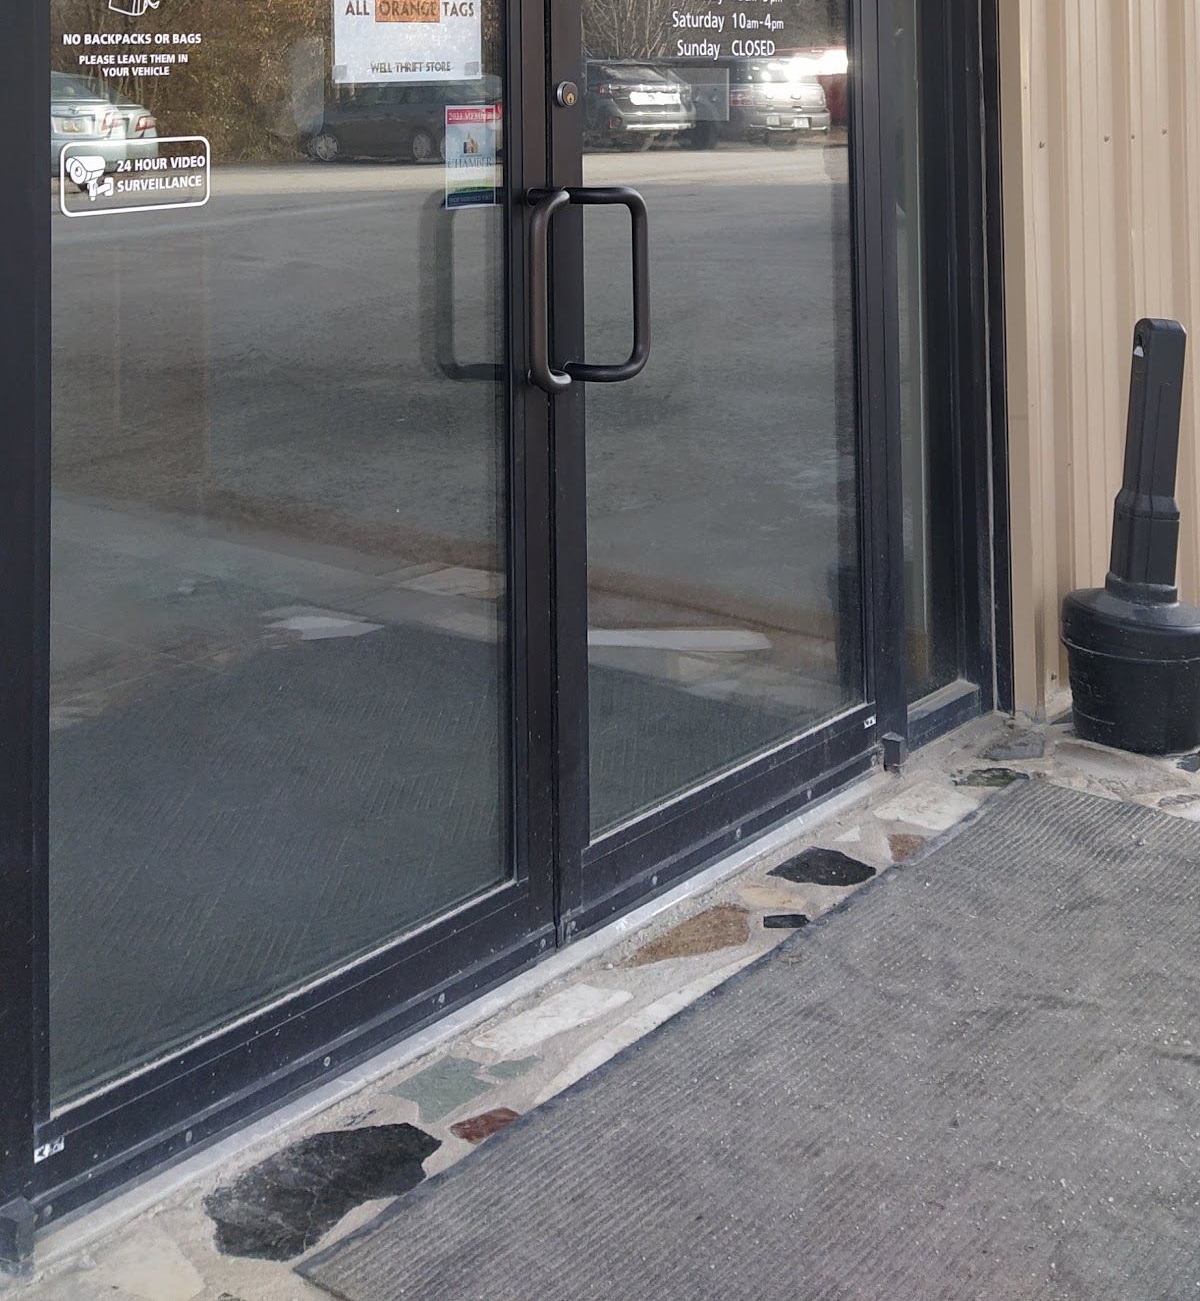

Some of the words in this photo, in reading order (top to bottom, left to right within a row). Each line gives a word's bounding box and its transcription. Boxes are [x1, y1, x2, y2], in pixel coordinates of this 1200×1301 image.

[345, 0, 370, 16] ALL
[379, 0, 437, 16] ORANGE
[443, 1, 474, 17] TAGS
[672, 11, 725, 33] Saturday
[63, 34, 81, 45] NO
[84, 34, 151, 45] BACKPACKS
[154, 34, 170, 44] OR
[172, 33, 201, 44] BAGS
[677, 39, 720, 61] Sunday
[732, 40, 775, 56] CLOSED
[79, 55, 115, 65] PLEASE
[117, 55, 148, 64] LEAVE
[150, 54, 175, 63] THEM
[178, 54, 188, 63] IN
[102, 67, 129, 77] YOUR
[132, 66, 170, 76] VEHICLE
[371, 62, 392, 73] WELL
[395, 62, 423, 72] THRIFT
[426, 61, 450, 72] STORE
[117, 160, 131, 172] 24
[135, 158, 167, 170] HOUR
[170, 156, 205, 169] VIDEO
[447, 156, 492, 169] CHAMBER
[117, 176, 202, 193] SURVEILLANCE
